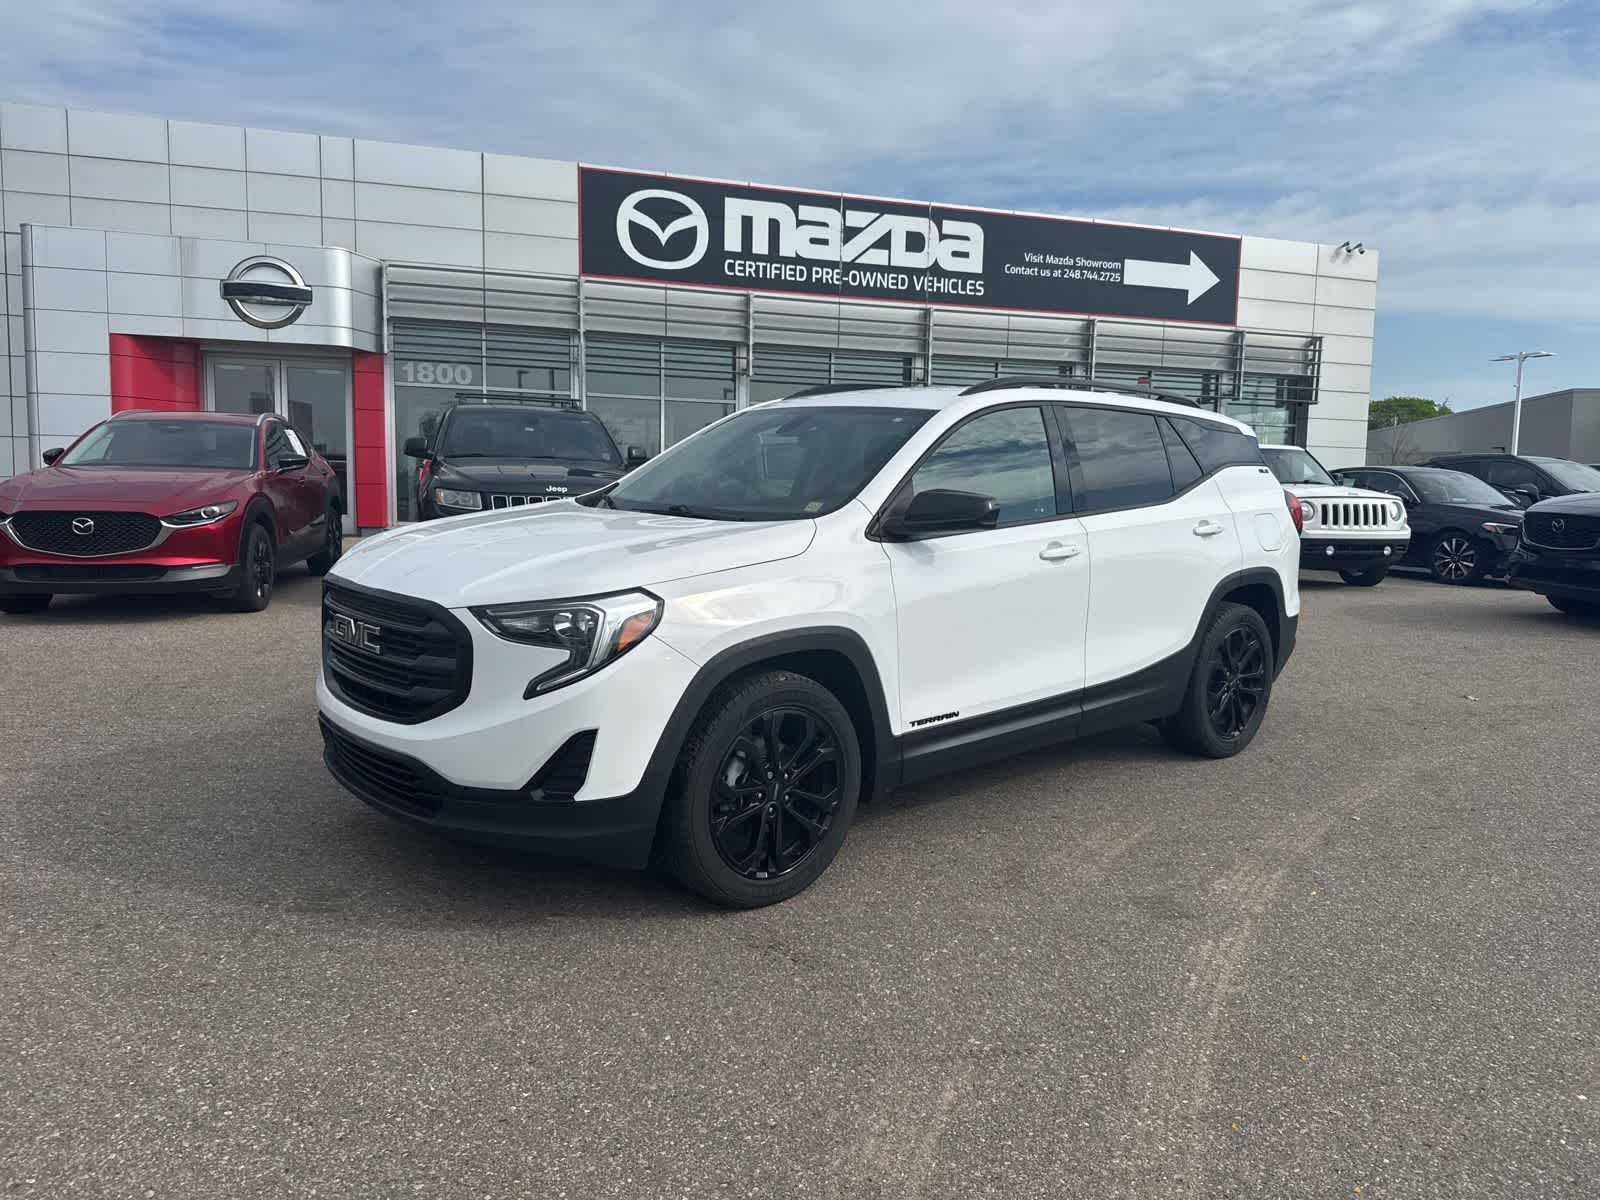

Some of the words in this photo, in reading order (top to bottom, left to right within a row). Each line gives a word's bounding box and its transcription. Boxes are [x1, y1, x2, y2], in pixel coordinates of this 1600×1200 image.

[1024, 252, 1044, 264] Visit
[1045, 254, 1074, 266] Mazda
[1075, 257, 1121, 270] Showroom
[724, 259, 807, 281] CERTIFIED
[812, 267, 909, 290] PRE-OWNED
[912, 275, 985, 296] VEHICLES
[1004, 263, 1038, 276] Contact
[1040, 269, 1051, 277] us
[1052, 269, 1062, 278] at
[1063, 268, 1121, 282] 248.744.2725
[402, 361, 473, 385] 1800
[545, 484, 568, 494] Jeep
[333, 613, 381, 654] GMC
[909, 710, 960, 727] TERRAIN
